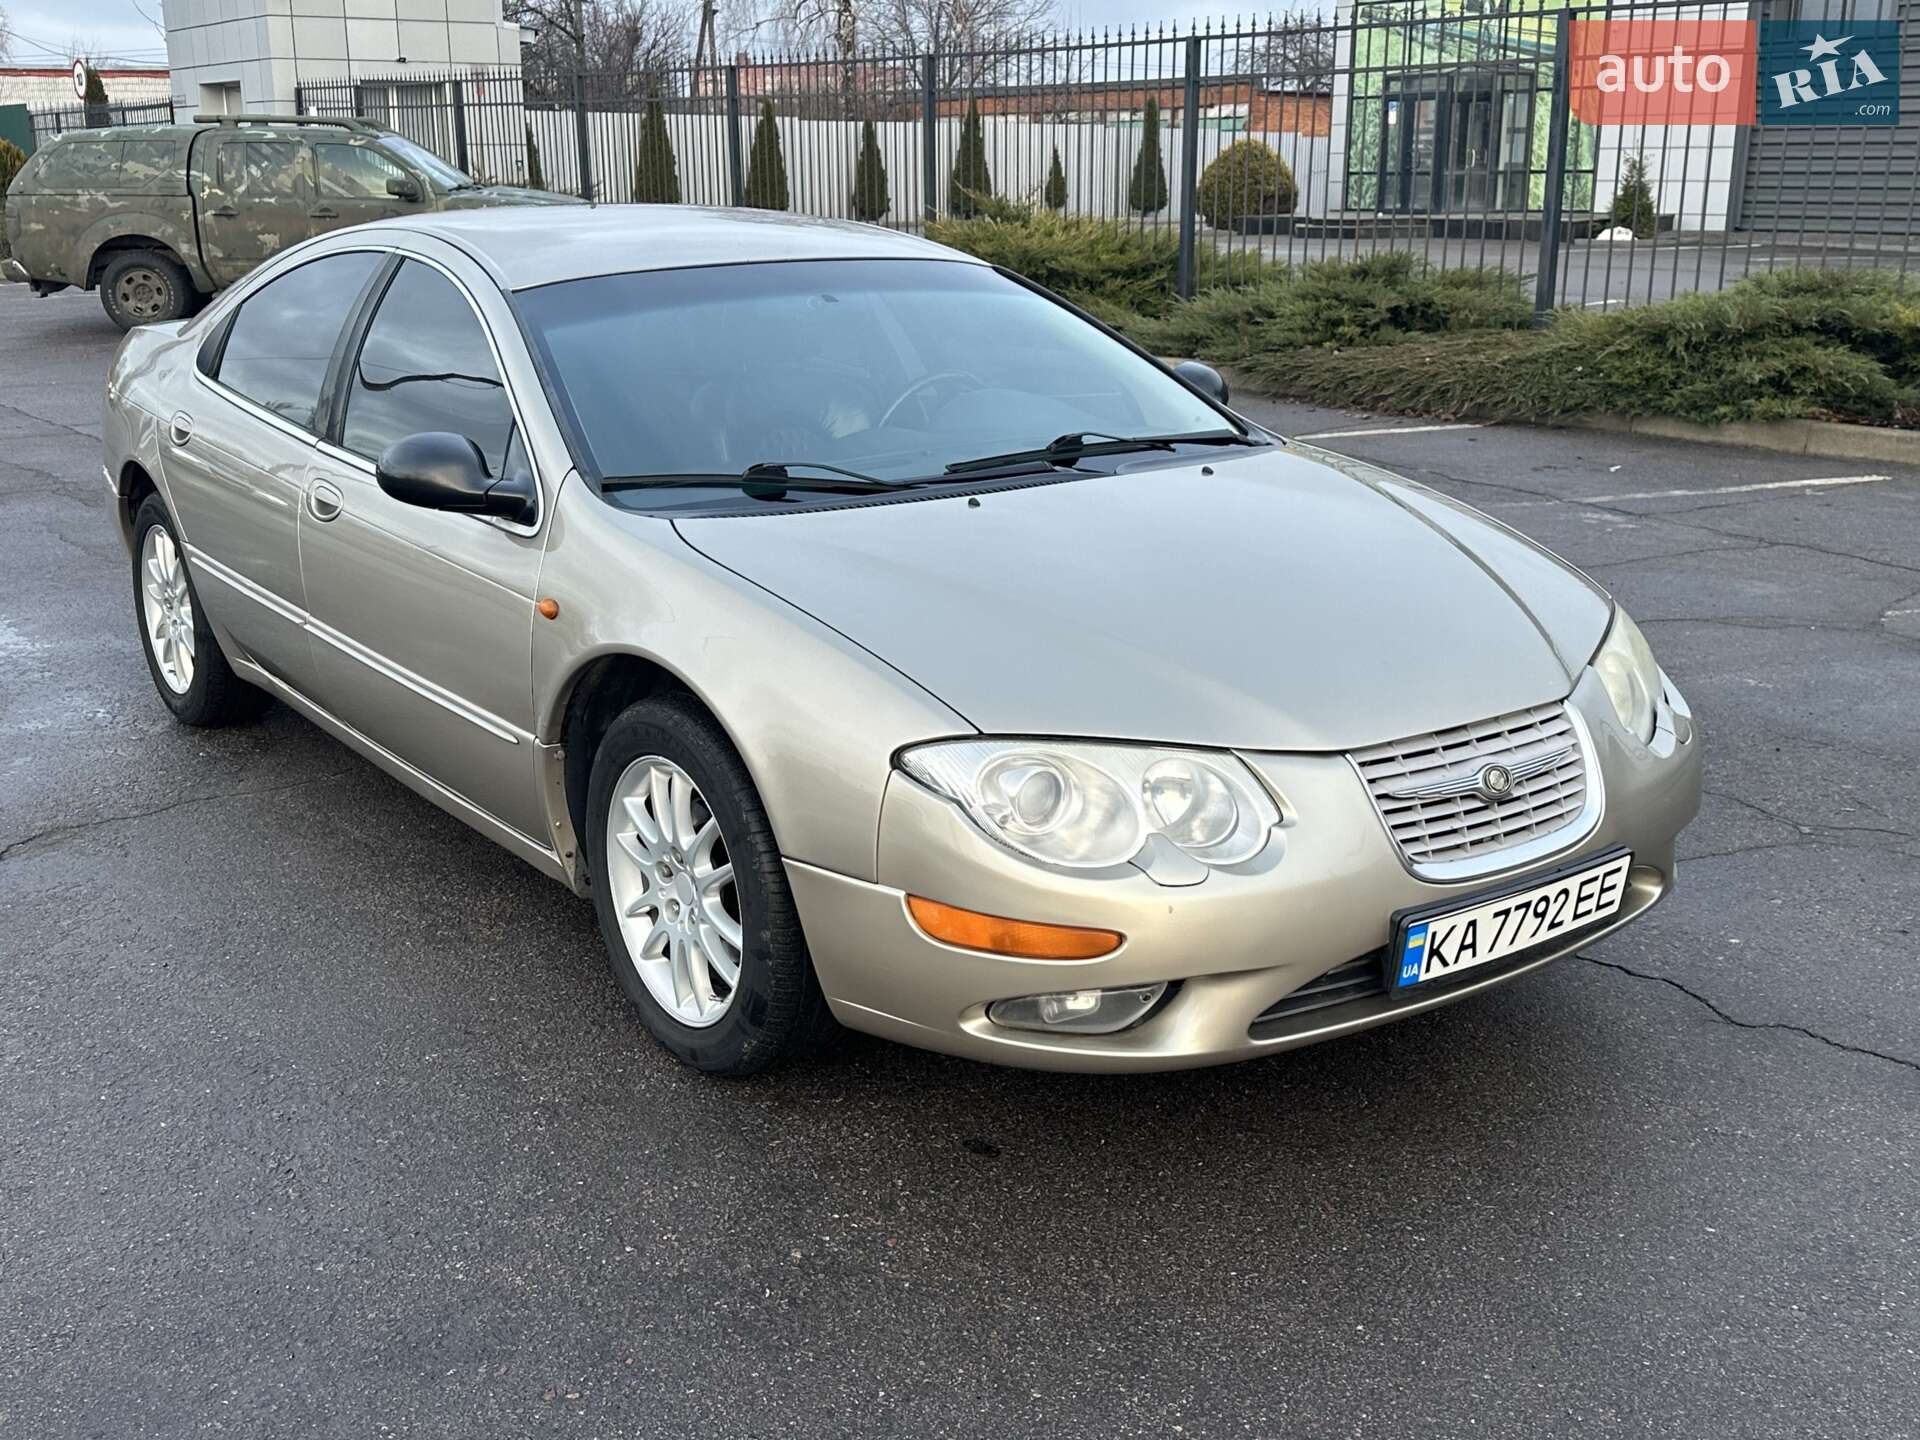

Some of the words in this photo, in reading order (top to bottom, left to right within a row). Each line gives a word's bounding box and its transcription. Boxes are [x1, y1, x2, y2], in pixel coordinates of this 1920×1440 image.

[1424, 918, 1478, 974] KA
[1487, 887, 1570, 953] 7792
[1572, 865, 1623, 922] EE
[1402, 964, 1420, 979] UA
